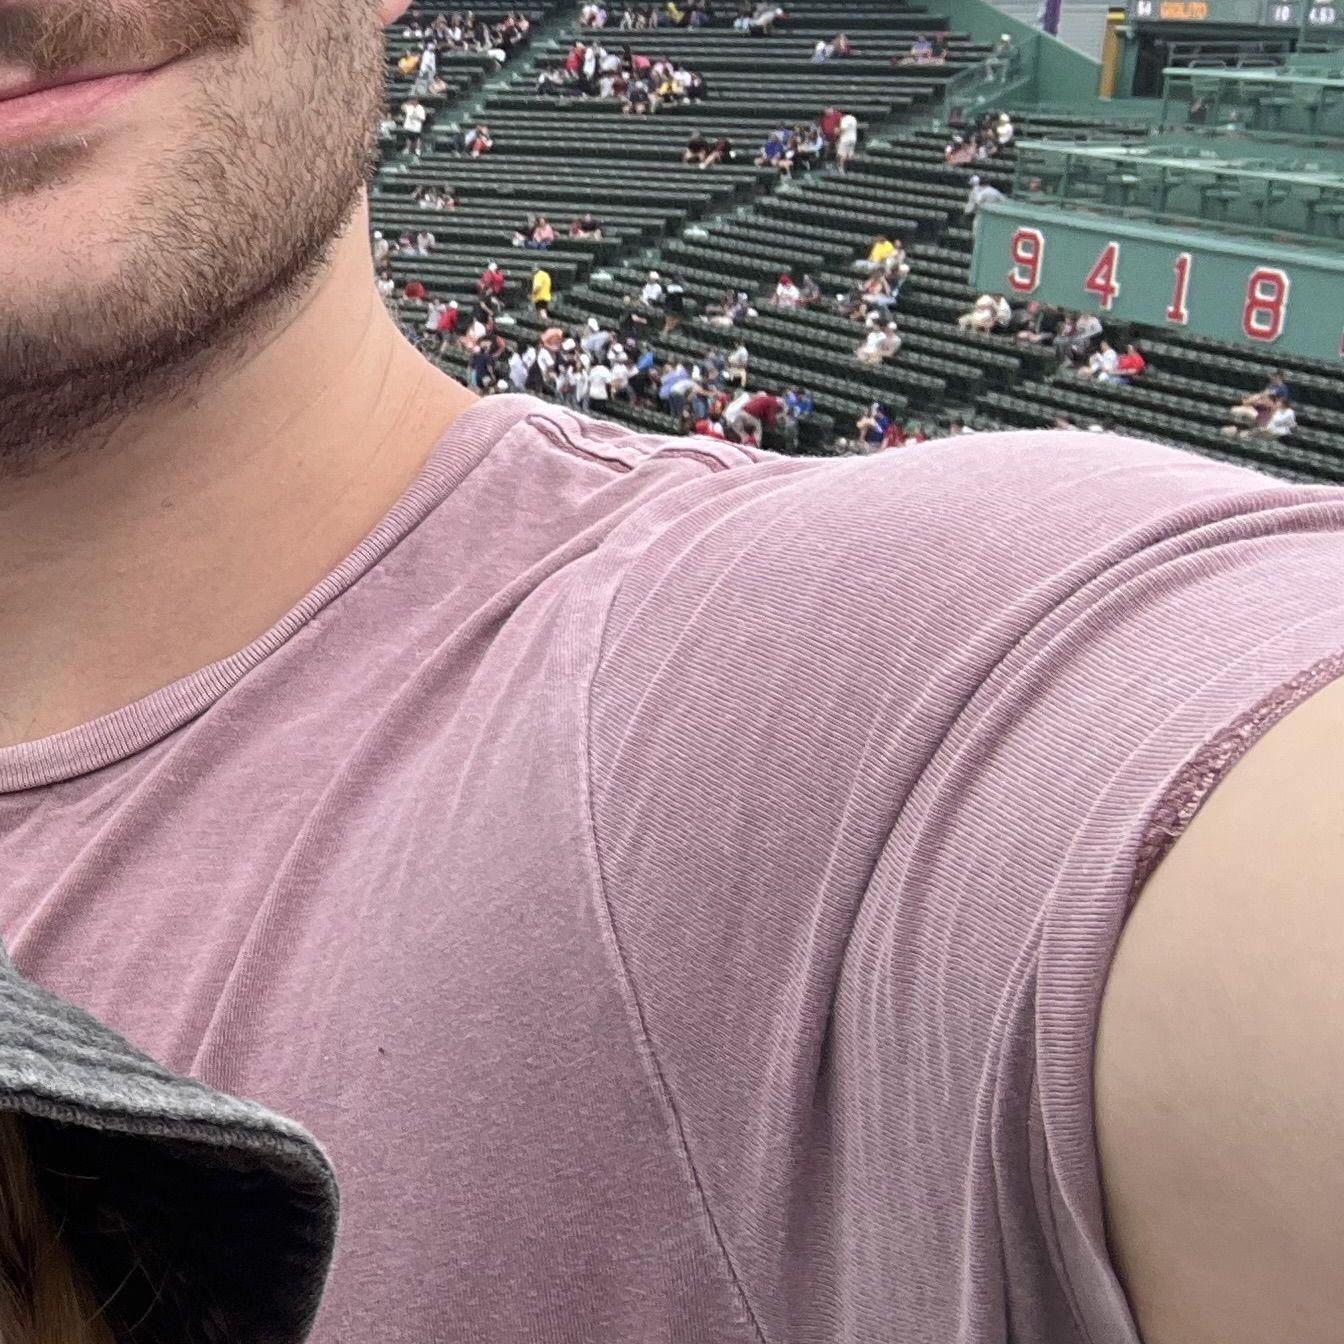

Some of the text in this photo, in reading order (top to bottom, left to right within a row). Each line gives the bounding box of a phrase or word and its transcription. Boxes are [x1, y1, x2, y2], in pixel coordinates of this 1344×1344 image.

[1009, 226, 1045, 294] 9
[1084, 241, 1120, 311] 4
[1165, 252, 1192, 326] 1
[1241, 266, 1290, 343] 8
